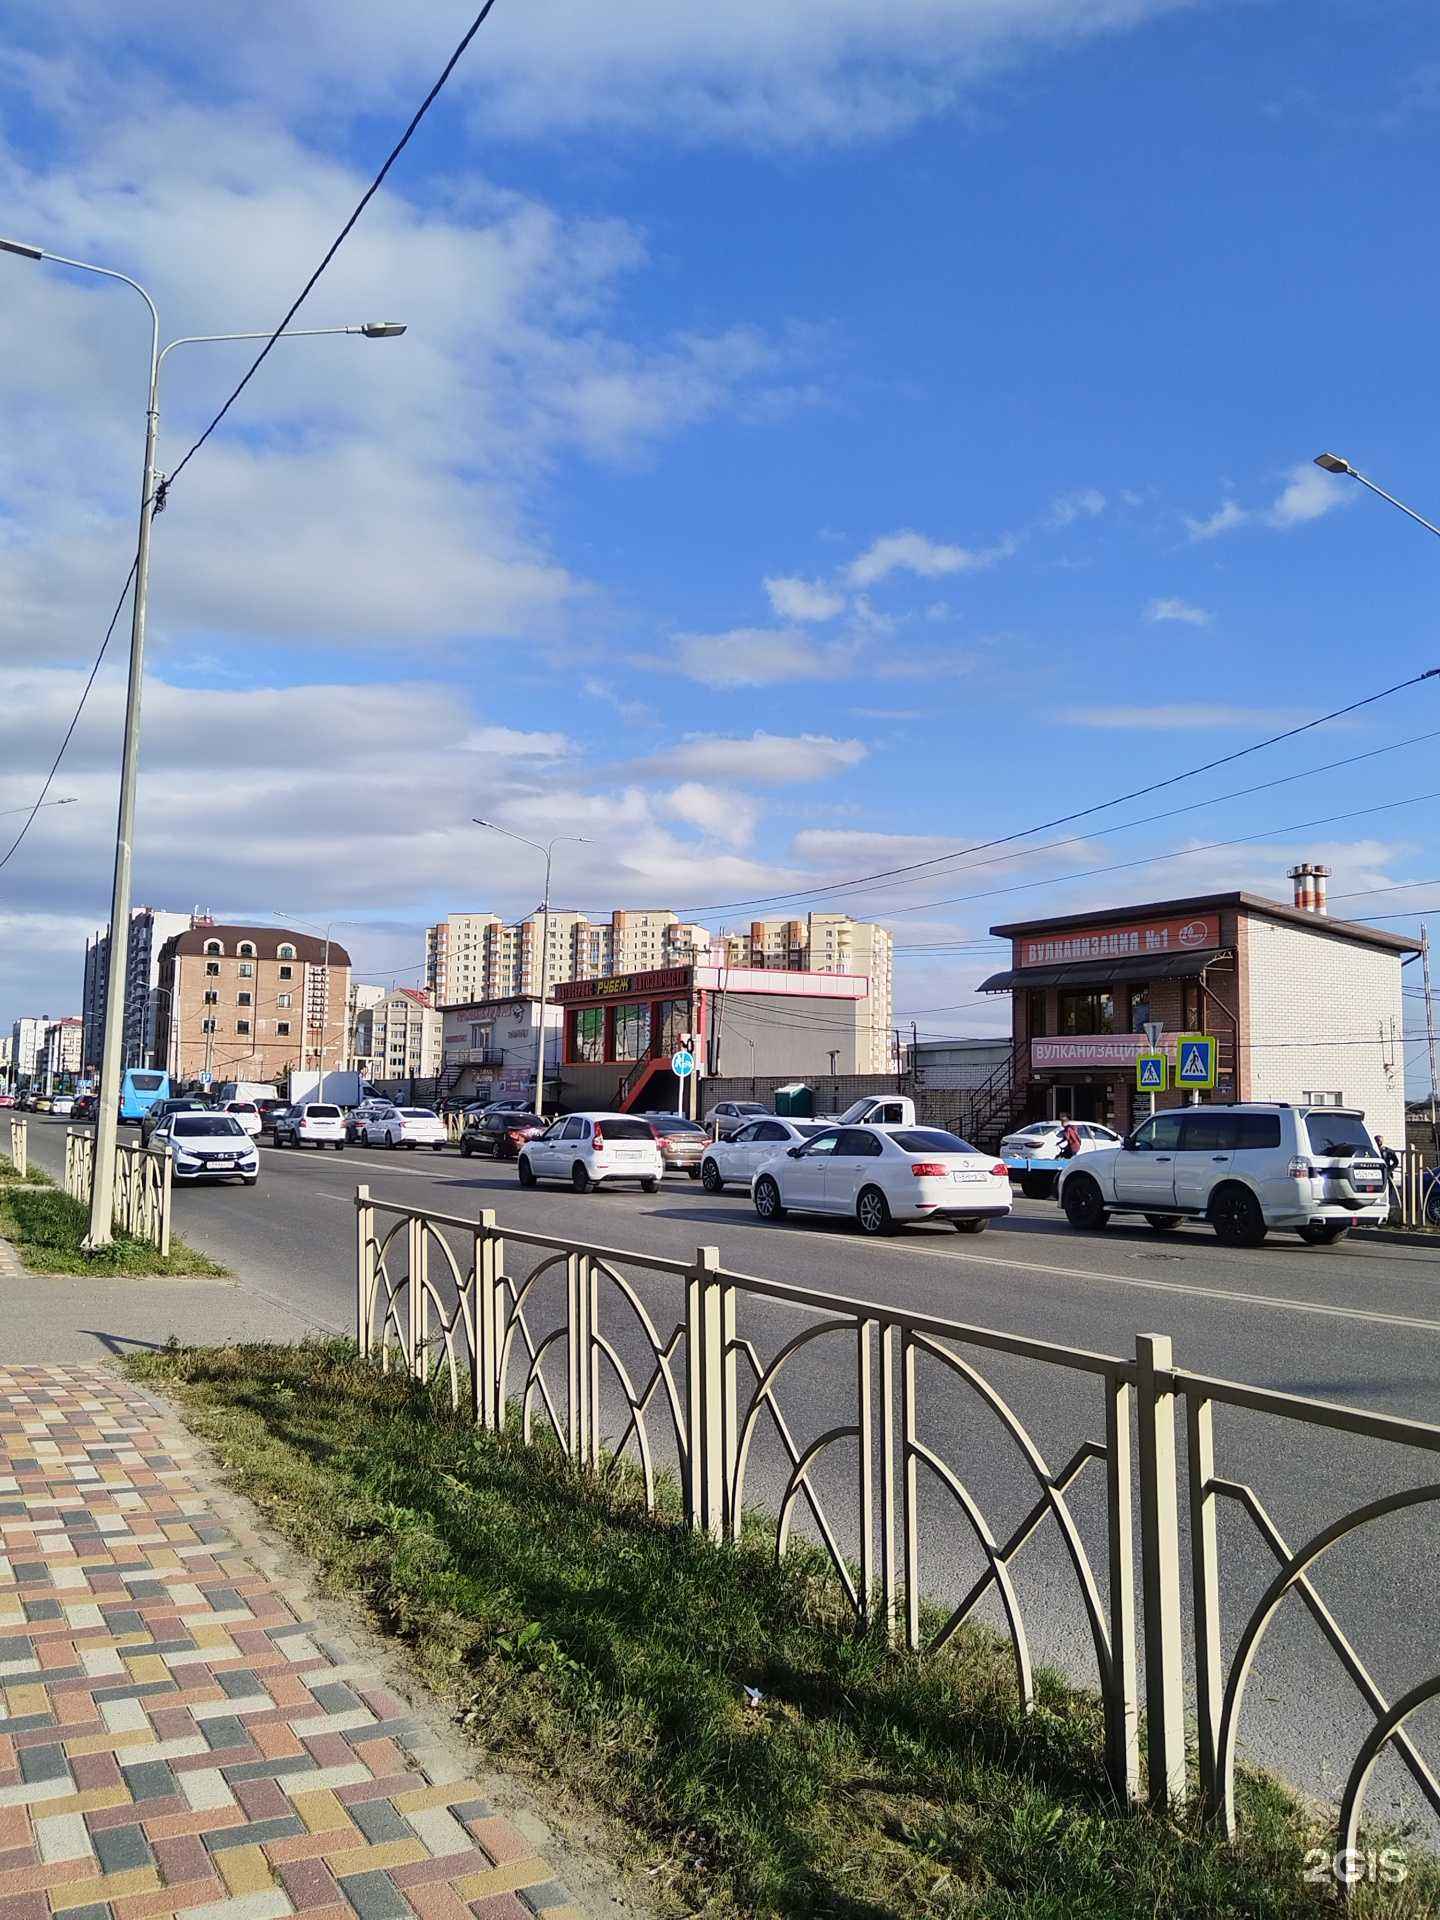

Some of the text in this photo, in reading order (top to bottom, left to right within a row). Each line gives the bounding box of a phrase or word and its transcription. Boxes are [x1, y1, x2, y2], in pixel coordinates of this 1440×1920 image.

[1028, 926, 1168, 962] ВУЛКАНИЗАЦИЯ №1
[596, 977, 629, 996] РУБЕЖ
